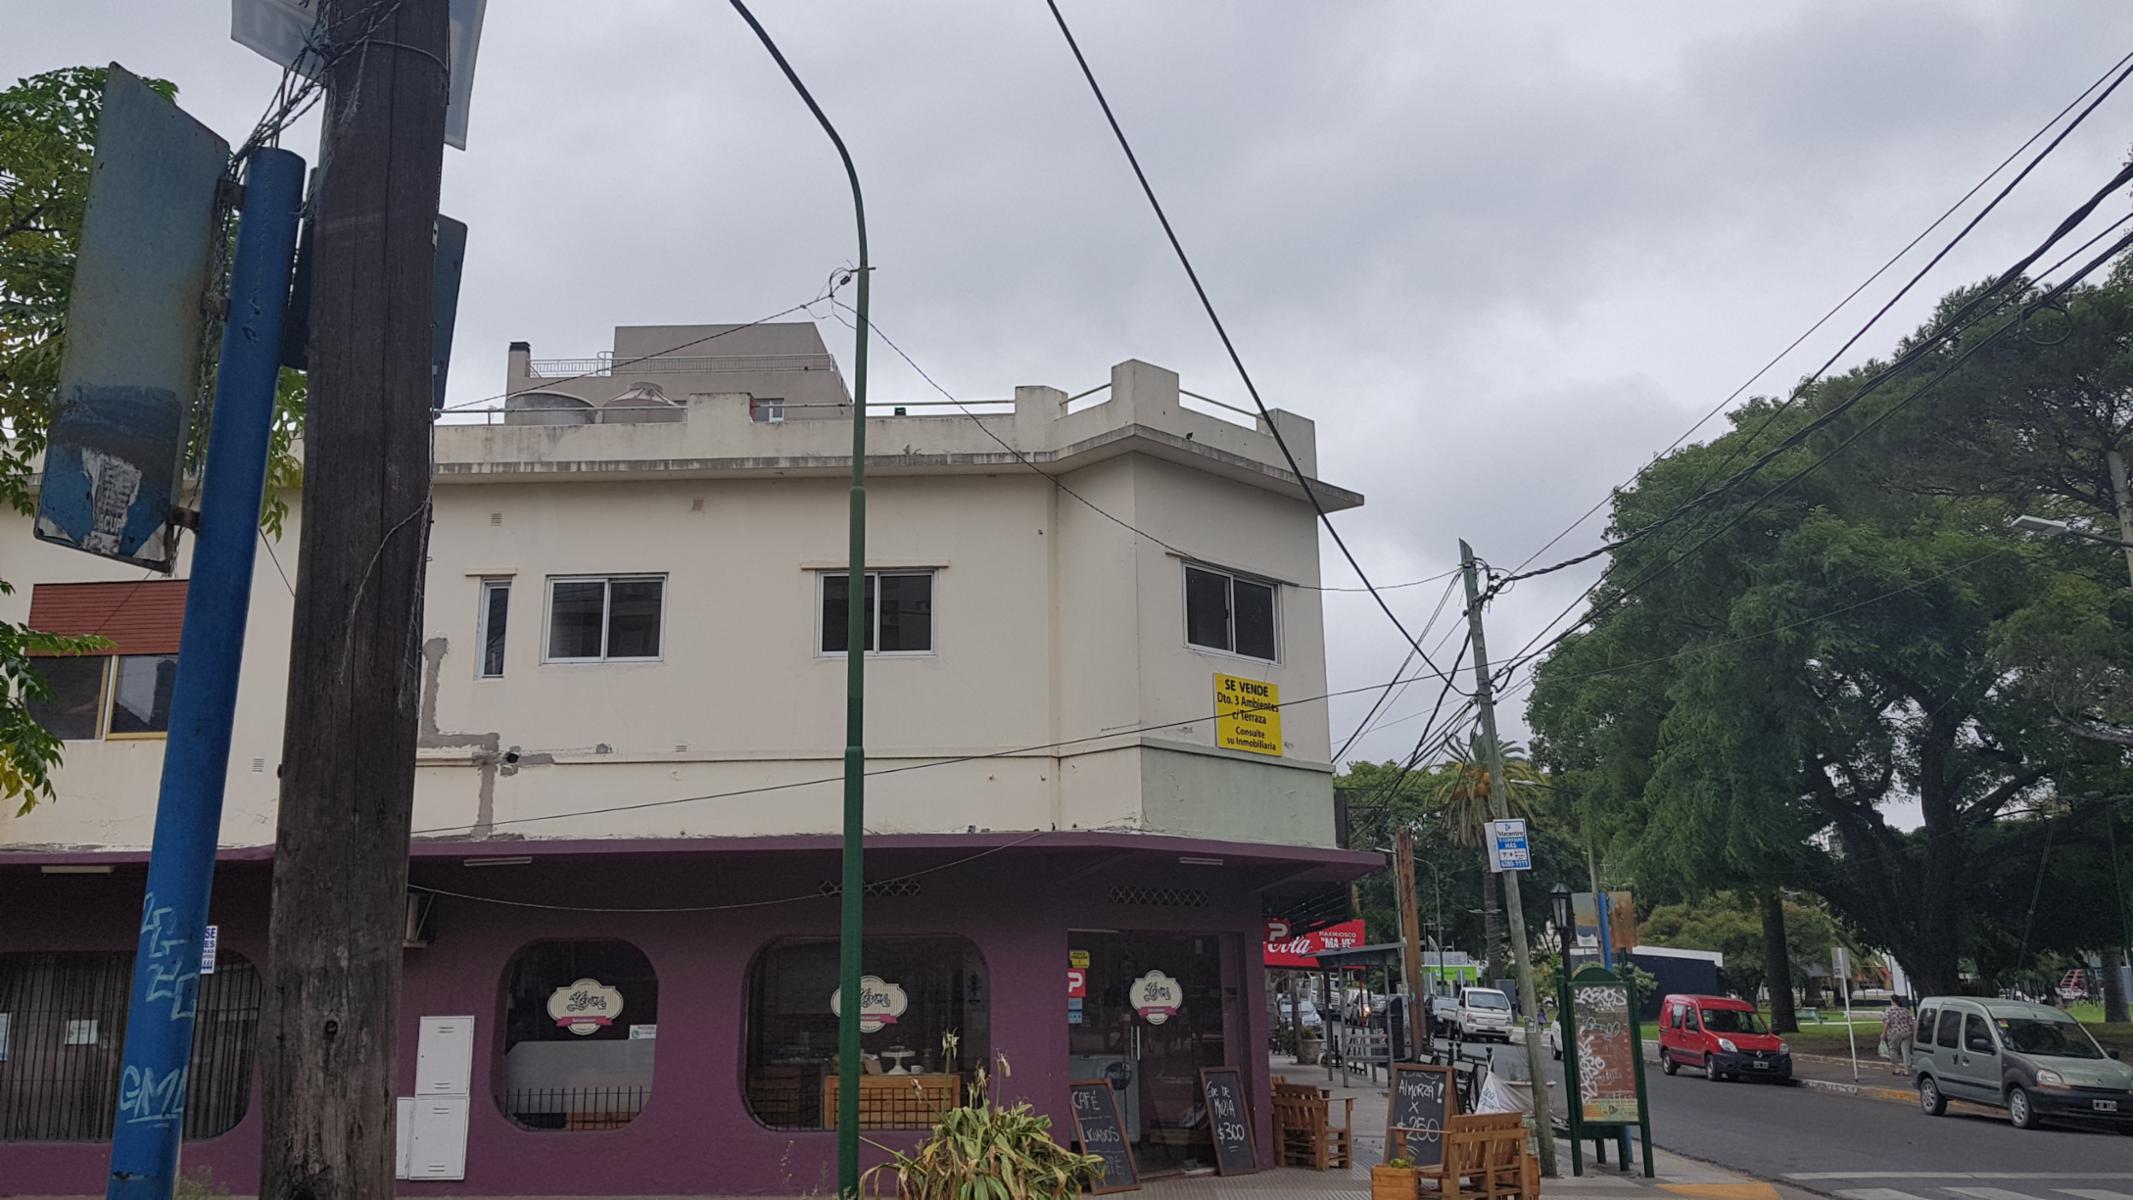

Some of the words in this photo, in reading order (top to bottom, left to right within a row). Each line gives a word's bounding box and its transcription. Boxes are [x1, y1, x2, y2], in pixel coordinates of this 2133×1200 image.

[1224, 679, 1236, 691] SE
[1239, 681, 1269, 697] VENDE
[1217, 692, 1233, 705] Dto.
[1234, 695, 1240, 706] 3
[1241, 696, 1279, 712] Ambientes
[1235, 726, 1265, 739] Consulte
[1227, 737, 1235, 745] su
[1236, 737, 1276, 751] Inmobiliaria
[1071, 1088, 1101, 1111] CAFÉ
[1216, 1121, 1245, 1145] $300
